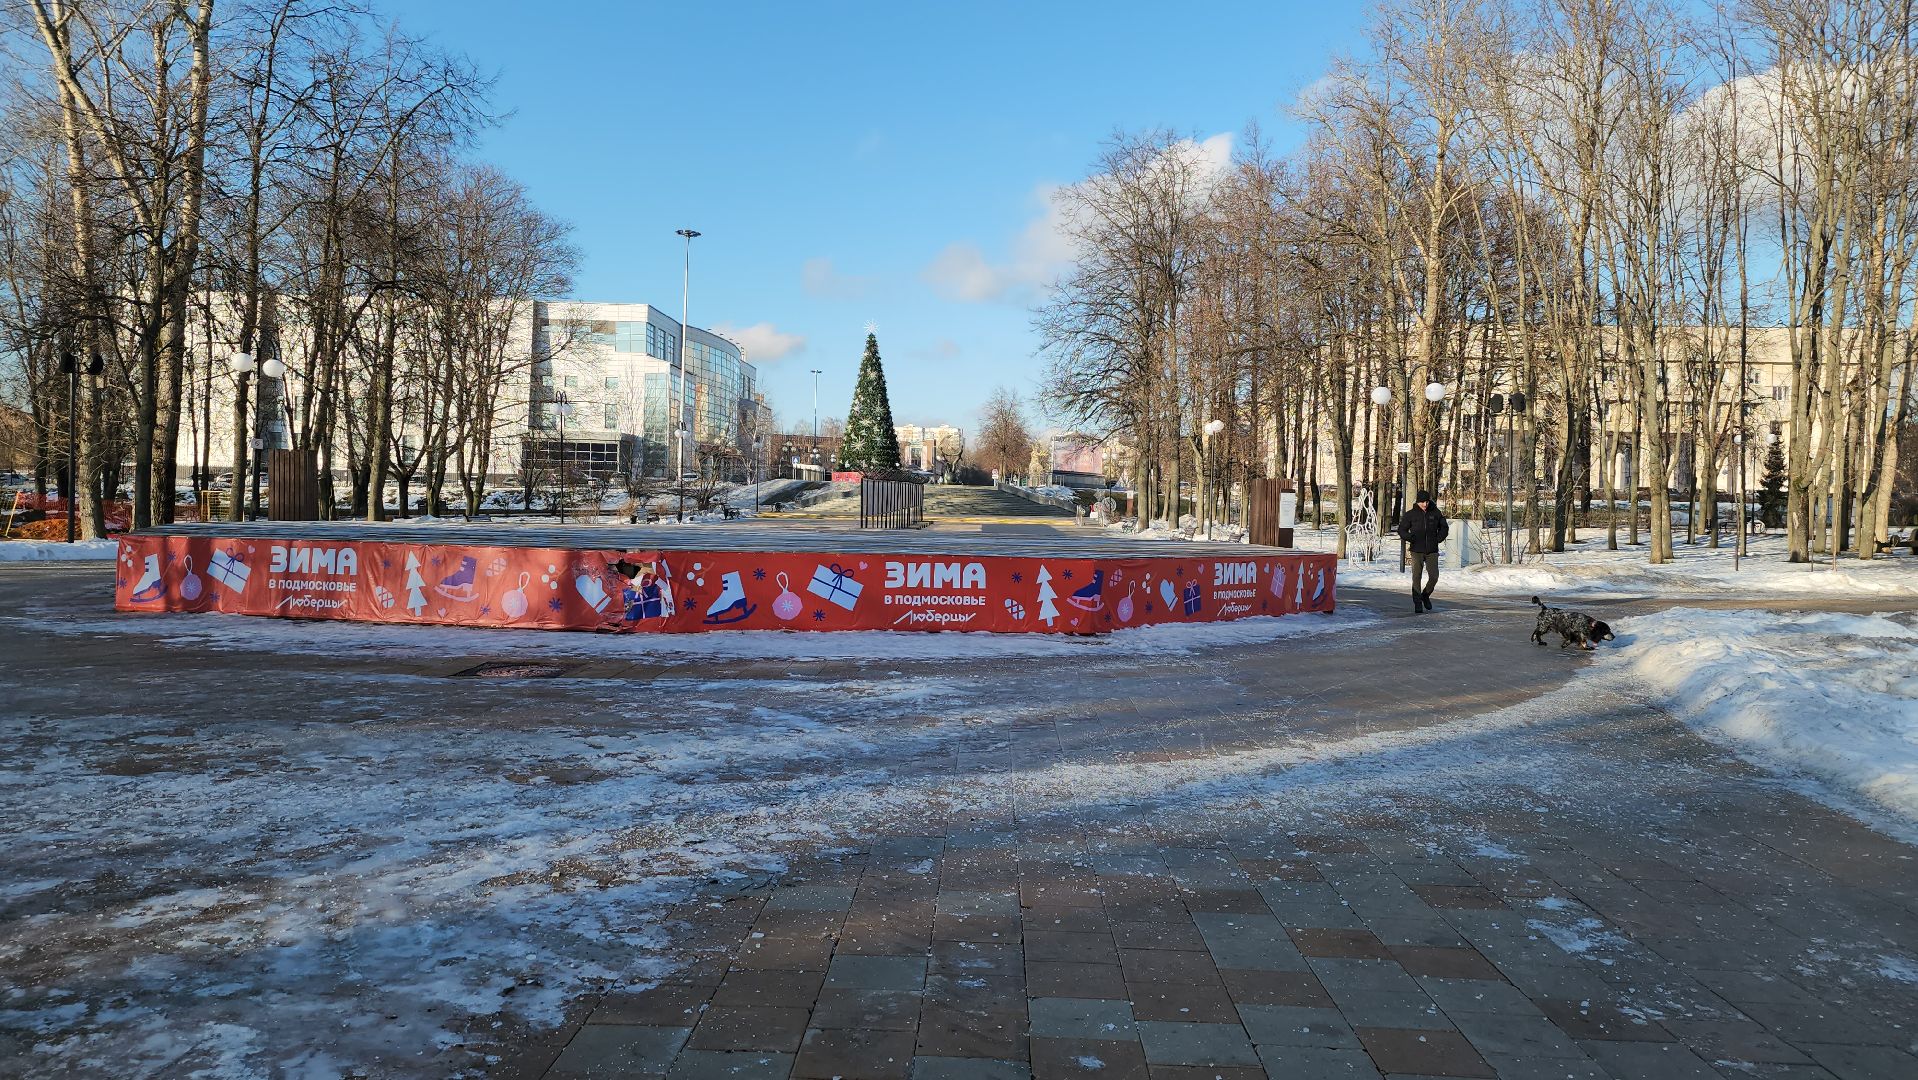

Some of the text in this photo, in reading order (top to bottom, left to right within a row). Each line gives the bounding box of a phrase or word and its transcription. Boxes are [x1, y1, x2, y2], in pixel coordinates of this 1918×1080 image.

[269, 546, 357, 575] ЗИМА
[884, 561, 987, 589] ЗИМА
[1214, 561, 1257, 586] ЗИМА
[268, 579, 357, 593] В ПОДМОСКОВЬЕ
[275, 595, 347, 611] Люберцы
[884, 595, 986, 606] В ПОДМОСКОВЬЕ
[893, 609, 977, 625] Люберцы
